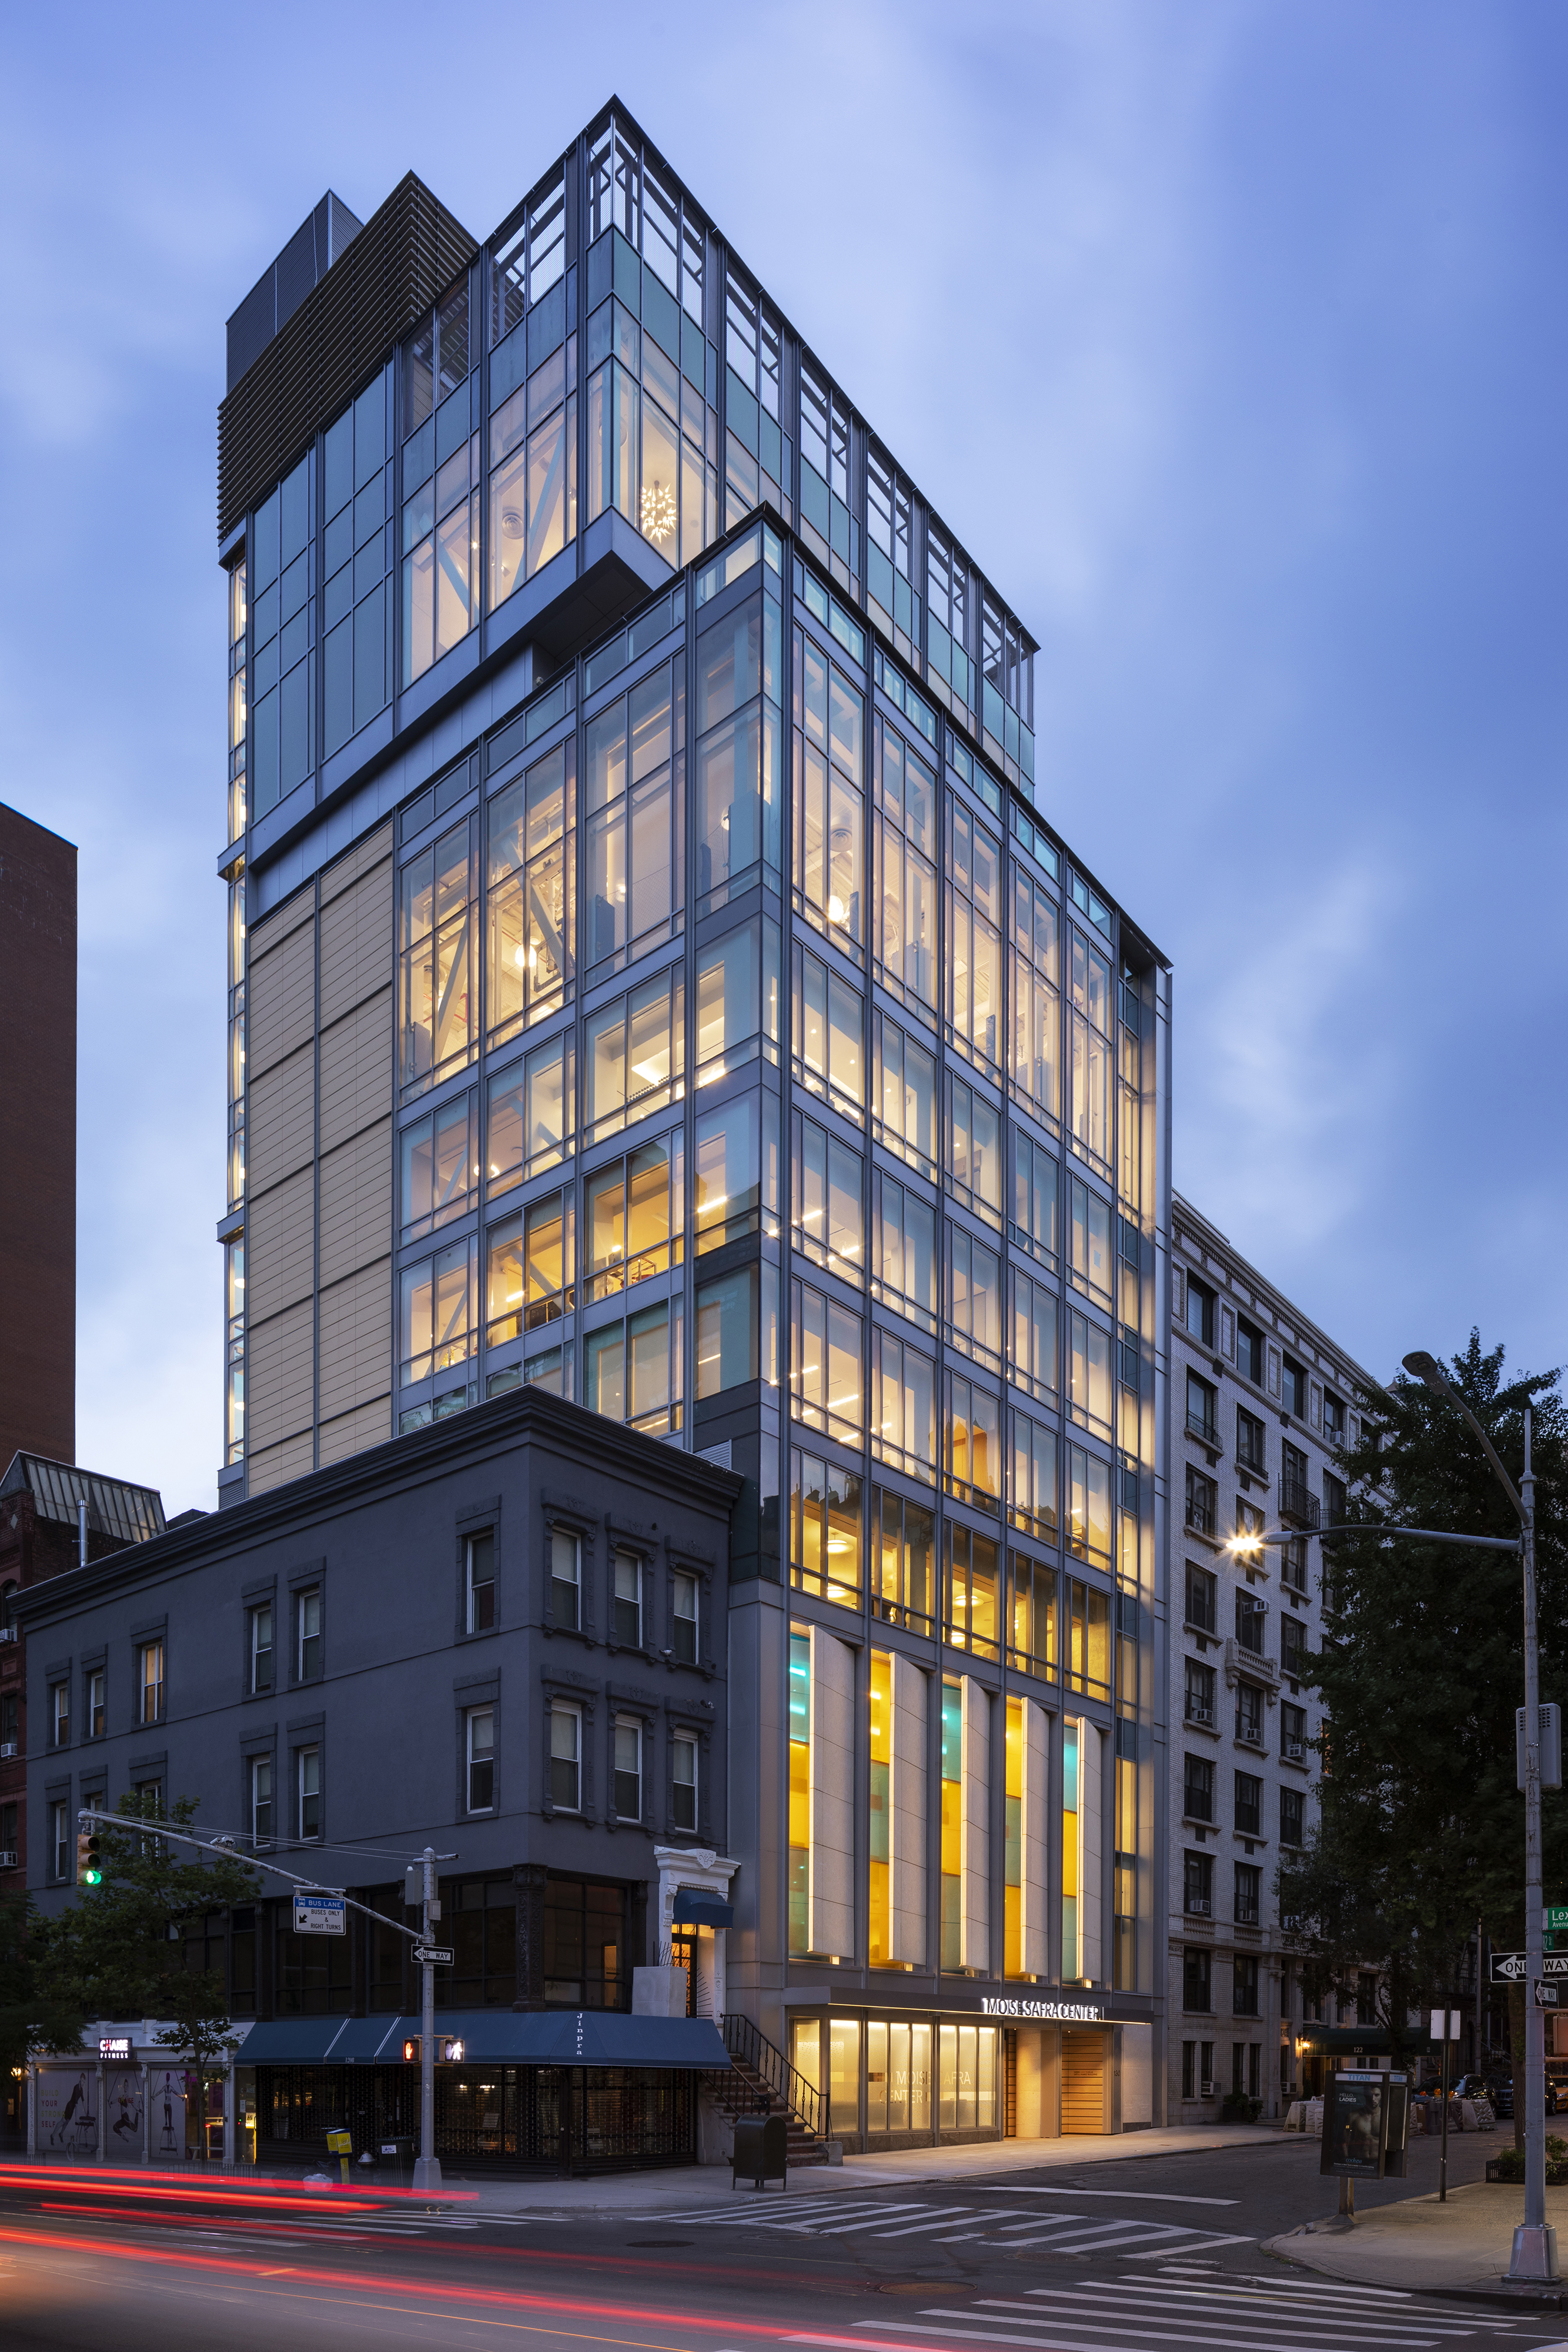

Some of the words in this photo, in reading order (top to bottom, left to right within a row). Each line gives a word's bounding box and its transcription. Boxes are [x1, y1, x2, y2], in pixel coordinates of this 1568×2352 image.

[1506, 1962, 1526, 1973] ON
[987, 1998, 1024, 2016] MOISE
[1024, 2001, 1058, 2019] SAFRA
[1060, 2003, 1100, 2020] CENTER
[100, 2039, 128, 2051] CHAISE
